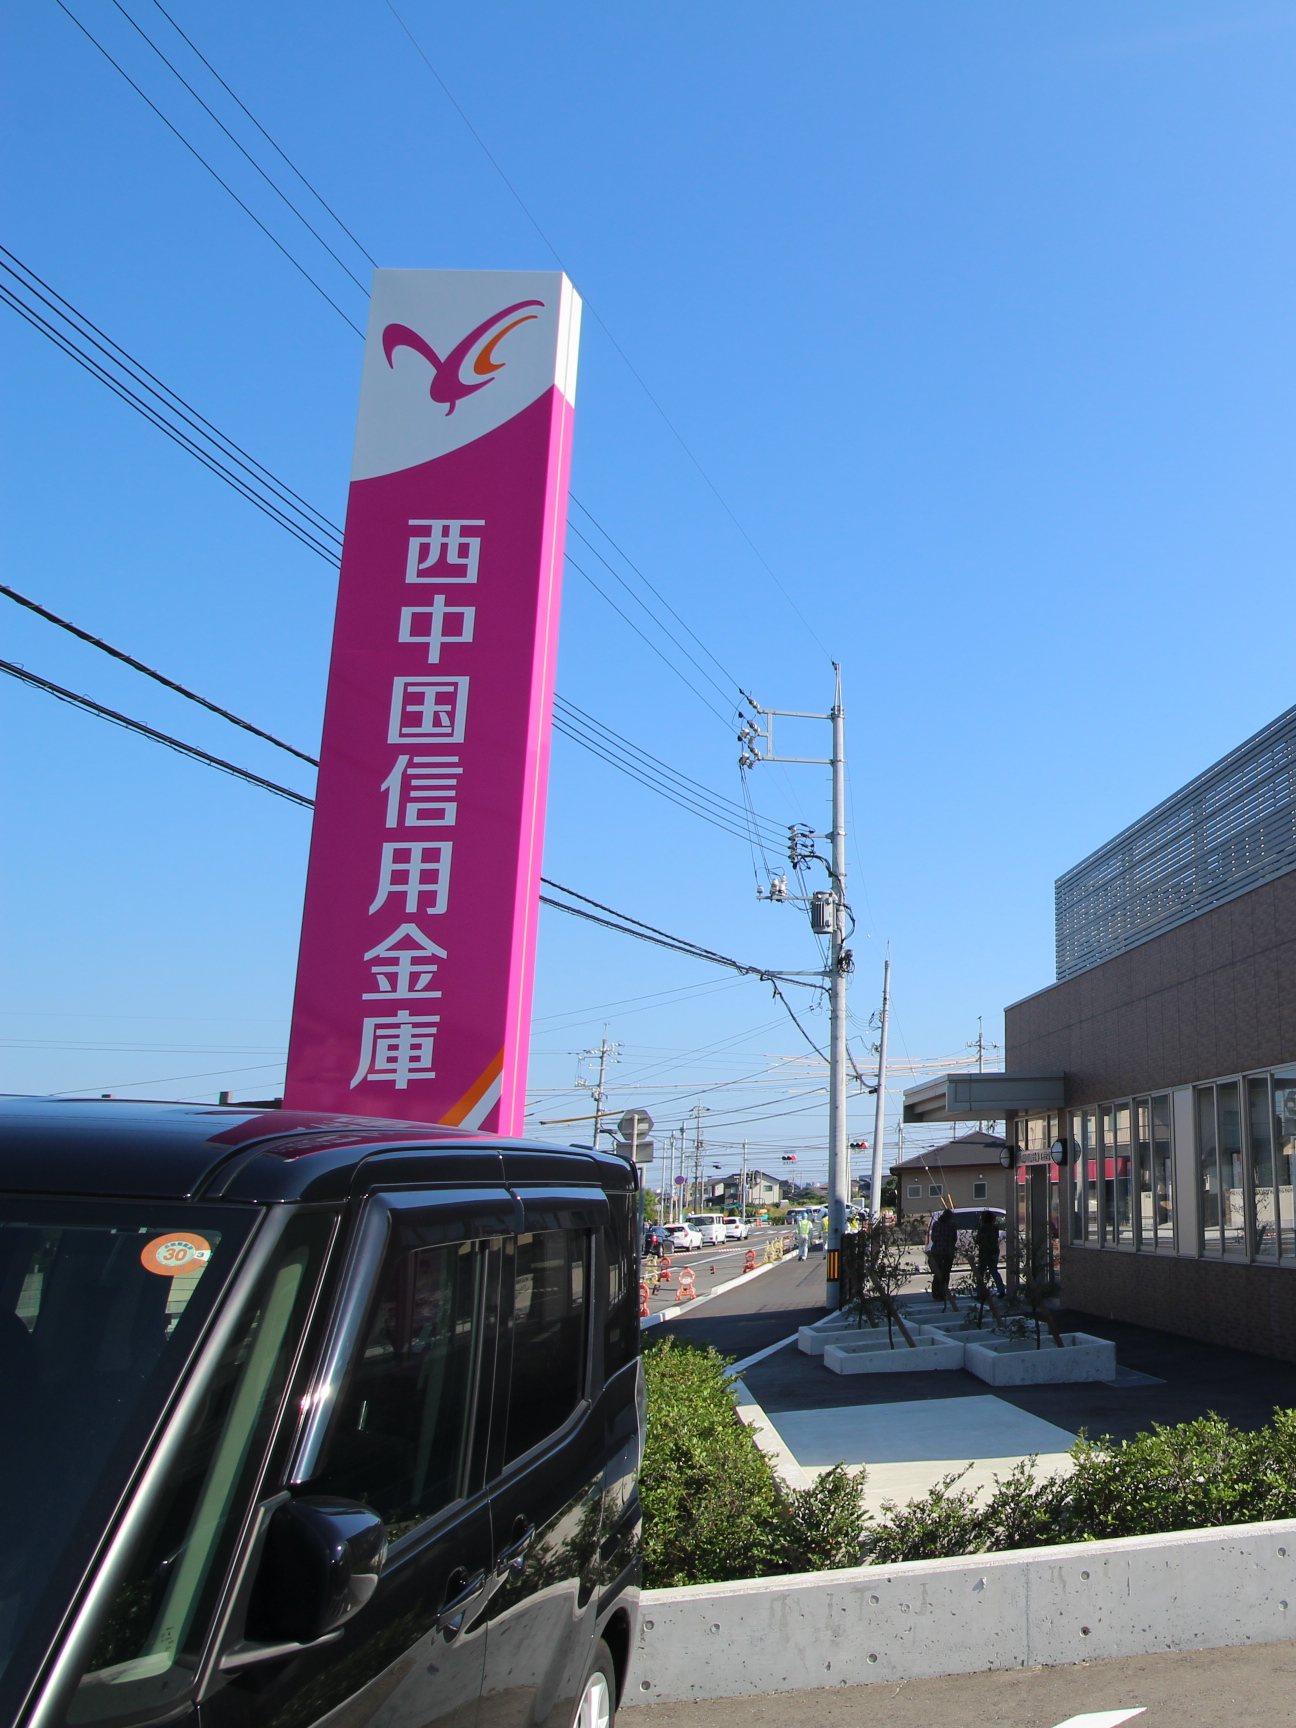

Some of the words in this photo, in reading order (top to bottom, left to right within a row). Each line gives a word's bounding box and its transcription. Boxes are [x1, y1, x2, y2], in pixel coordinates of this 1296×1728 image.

[350, 518, 485, 1090] 西中国信用金庫
[163, 1247, 188, 1262] 30
